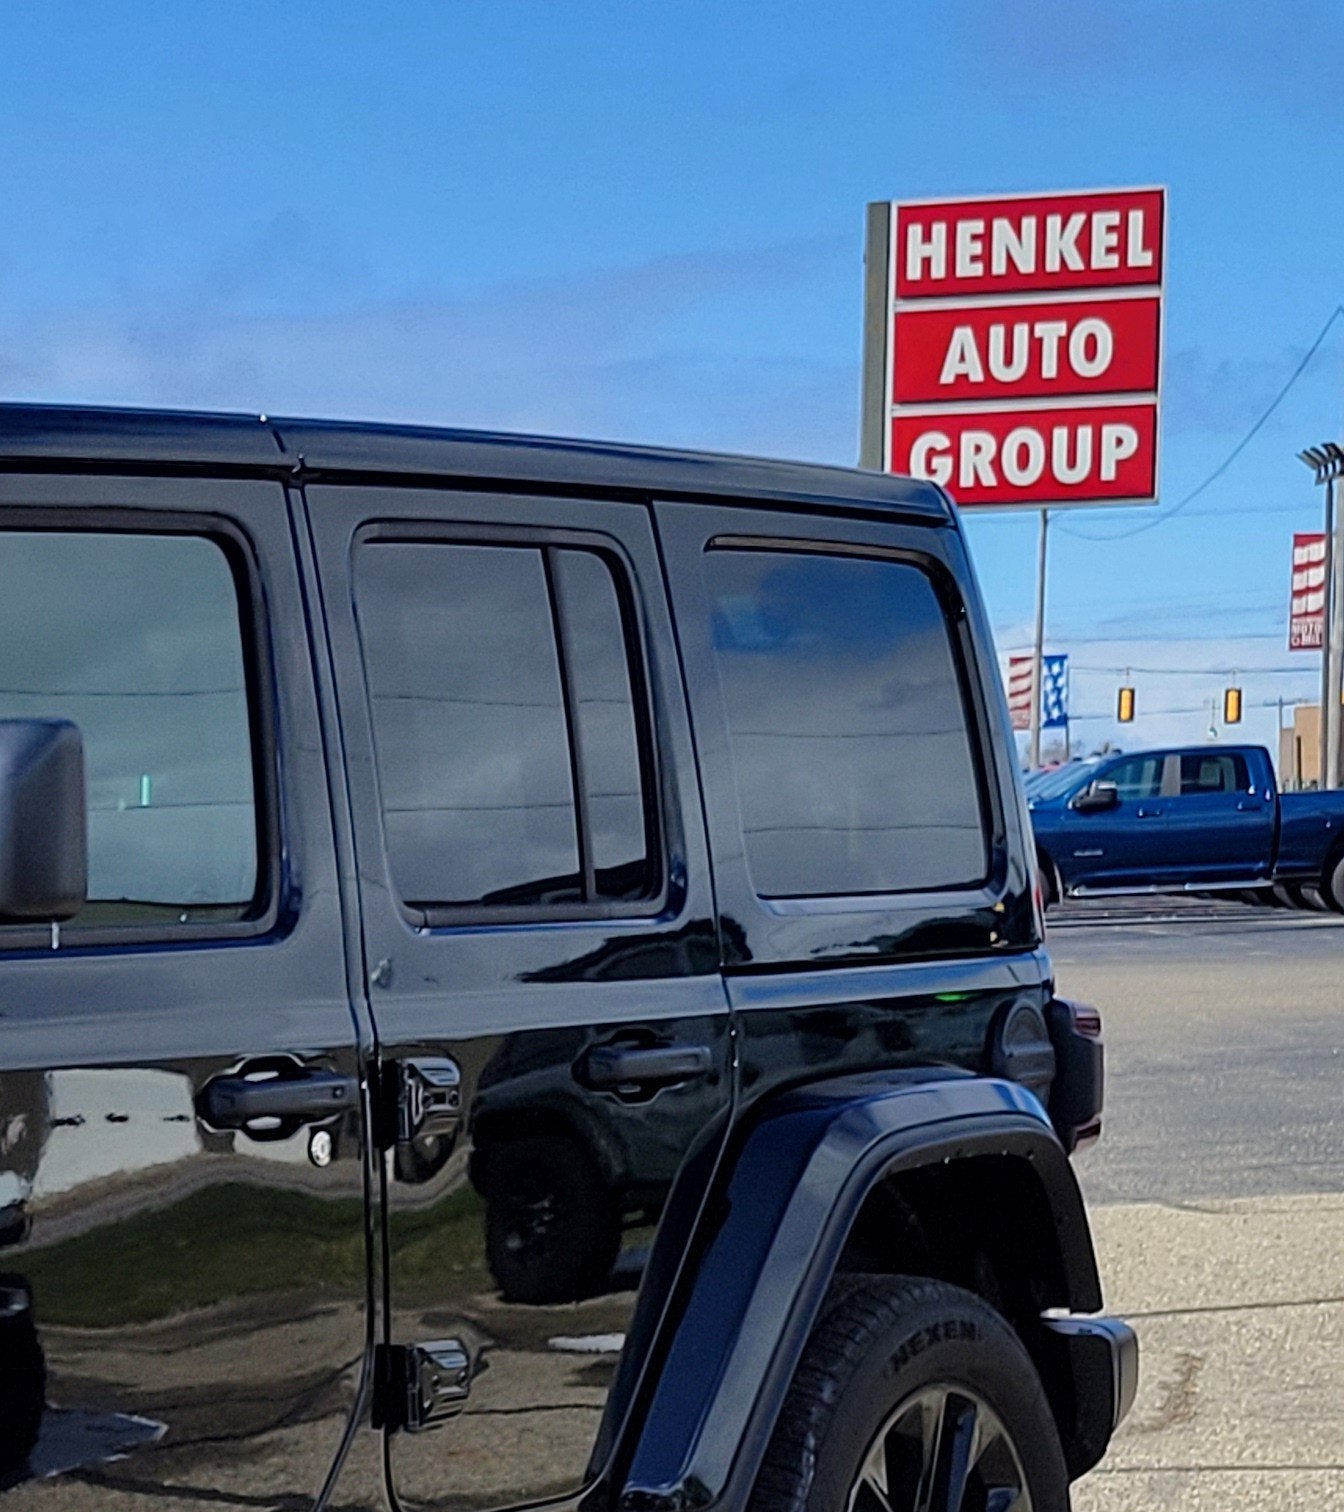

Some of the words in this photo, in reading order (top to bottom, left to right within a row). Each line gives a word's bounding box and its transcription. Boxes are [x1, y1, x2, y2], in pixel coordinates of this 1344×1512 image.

[906, 209, 1153, 281] HENKEL
[939, 317, 1114, 385] AUTO
[910, 423, 1139, 489] GROUP
[891, 1319, 976, 1373] NEXEN
